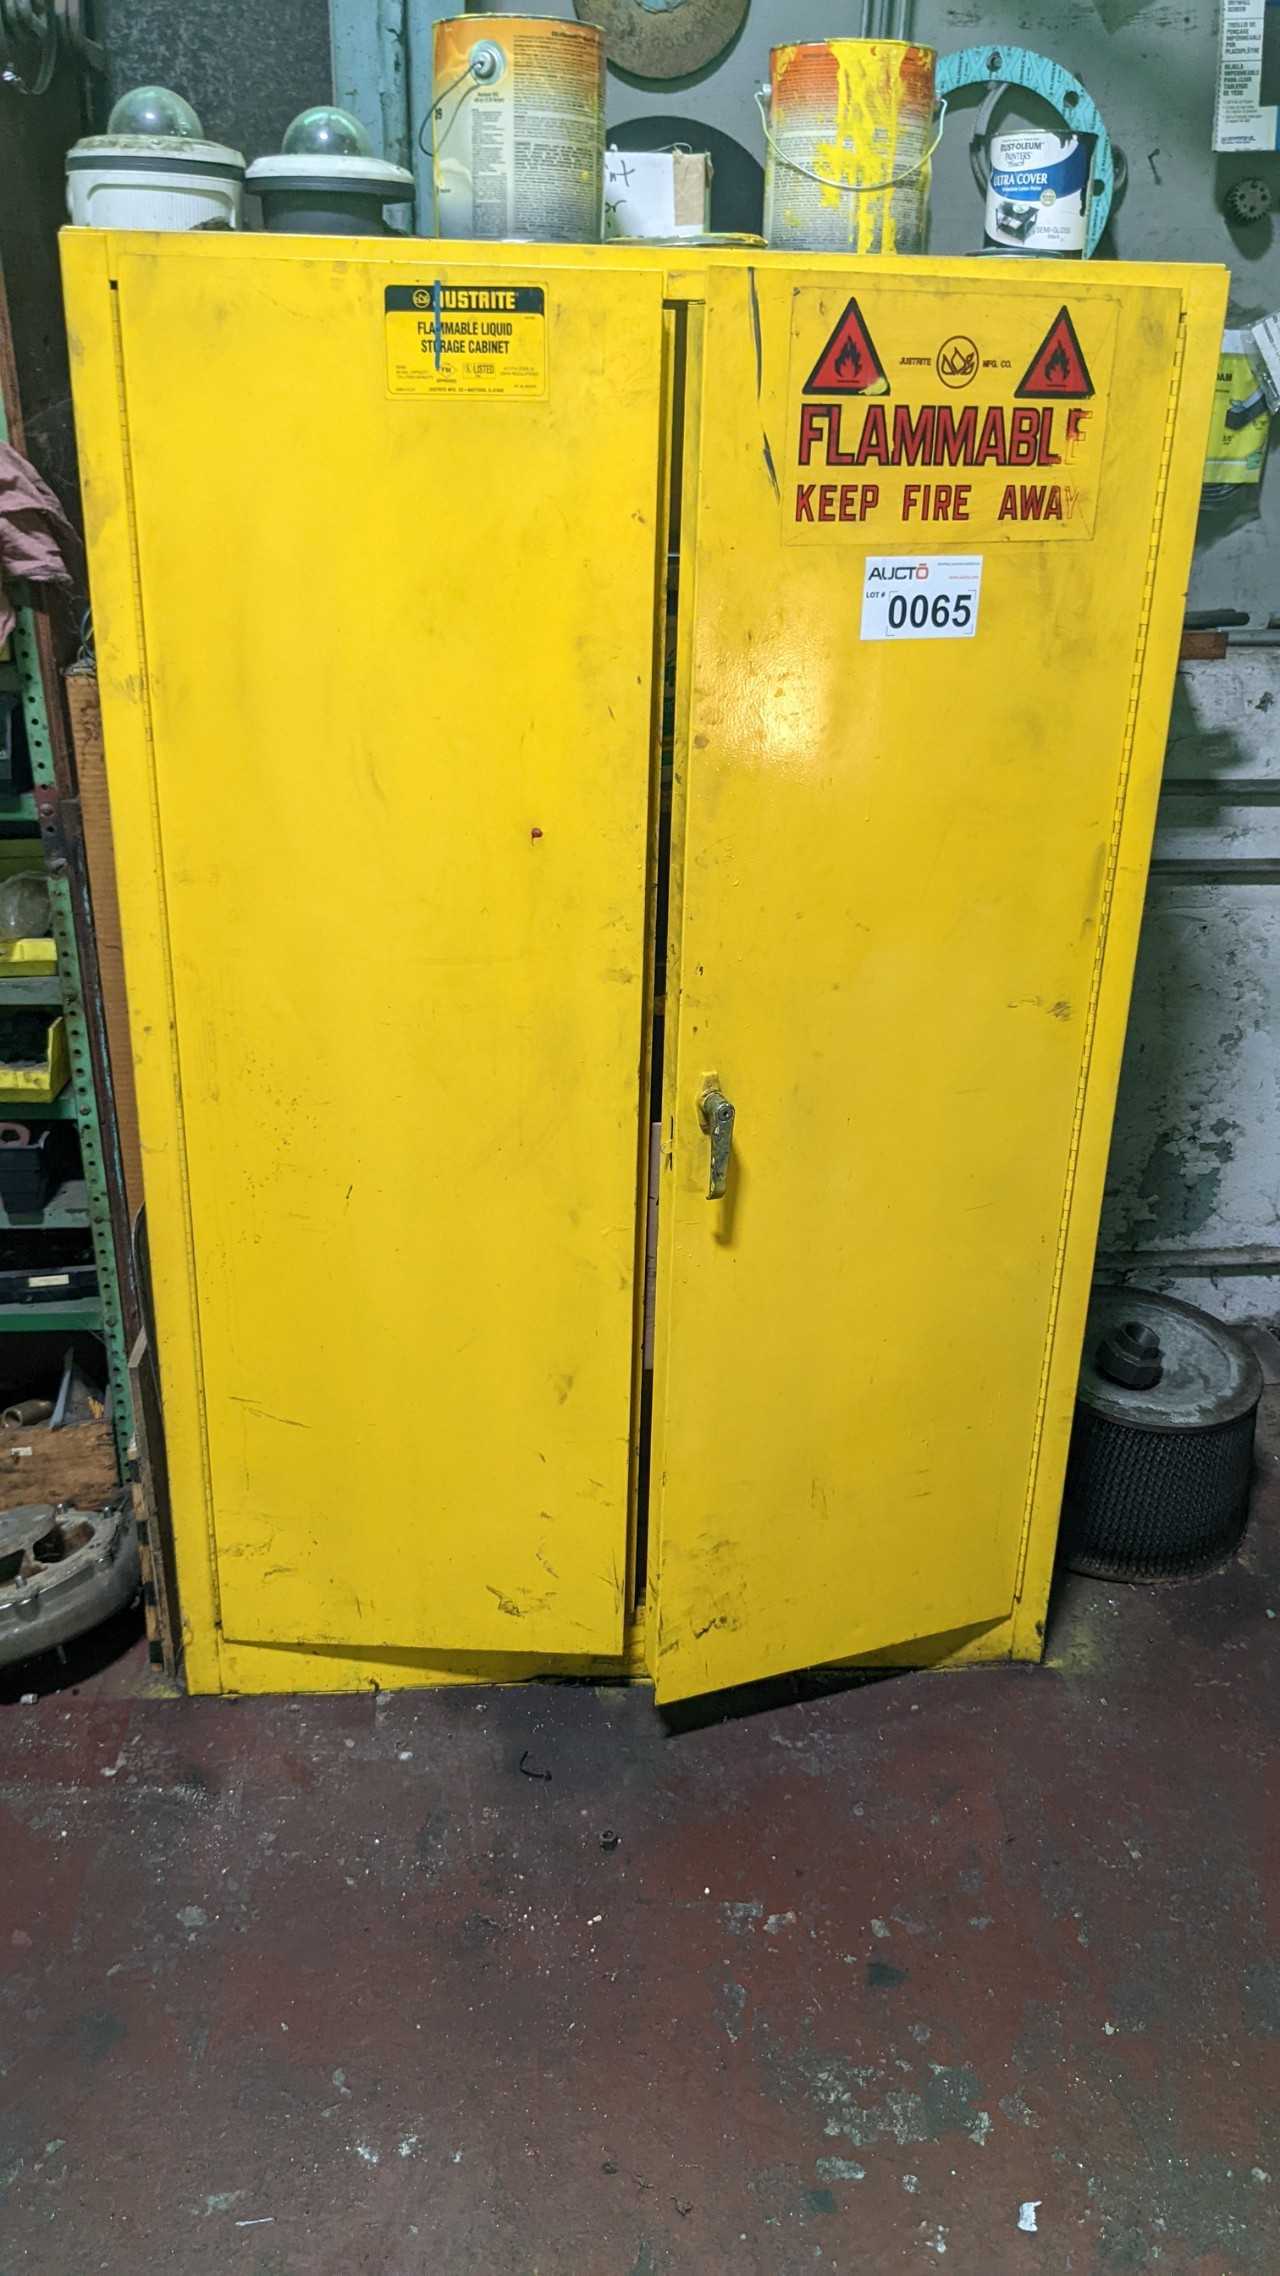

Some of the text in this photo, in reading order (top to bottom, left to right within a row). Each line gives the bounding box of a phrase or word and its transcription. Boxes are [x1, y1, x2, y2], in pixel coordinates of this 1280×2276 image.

[1017, 173, 1048, 185] COVER
[481, 322, 512, 337] LIQUID
[468, 341, 509, 354] CABINET
[798, 403, 1093, 466] FLAMMABLE
[795, 484, 1079, 522] KEEP FIRE AWAY
[888, 594, 972, 629] 0065
